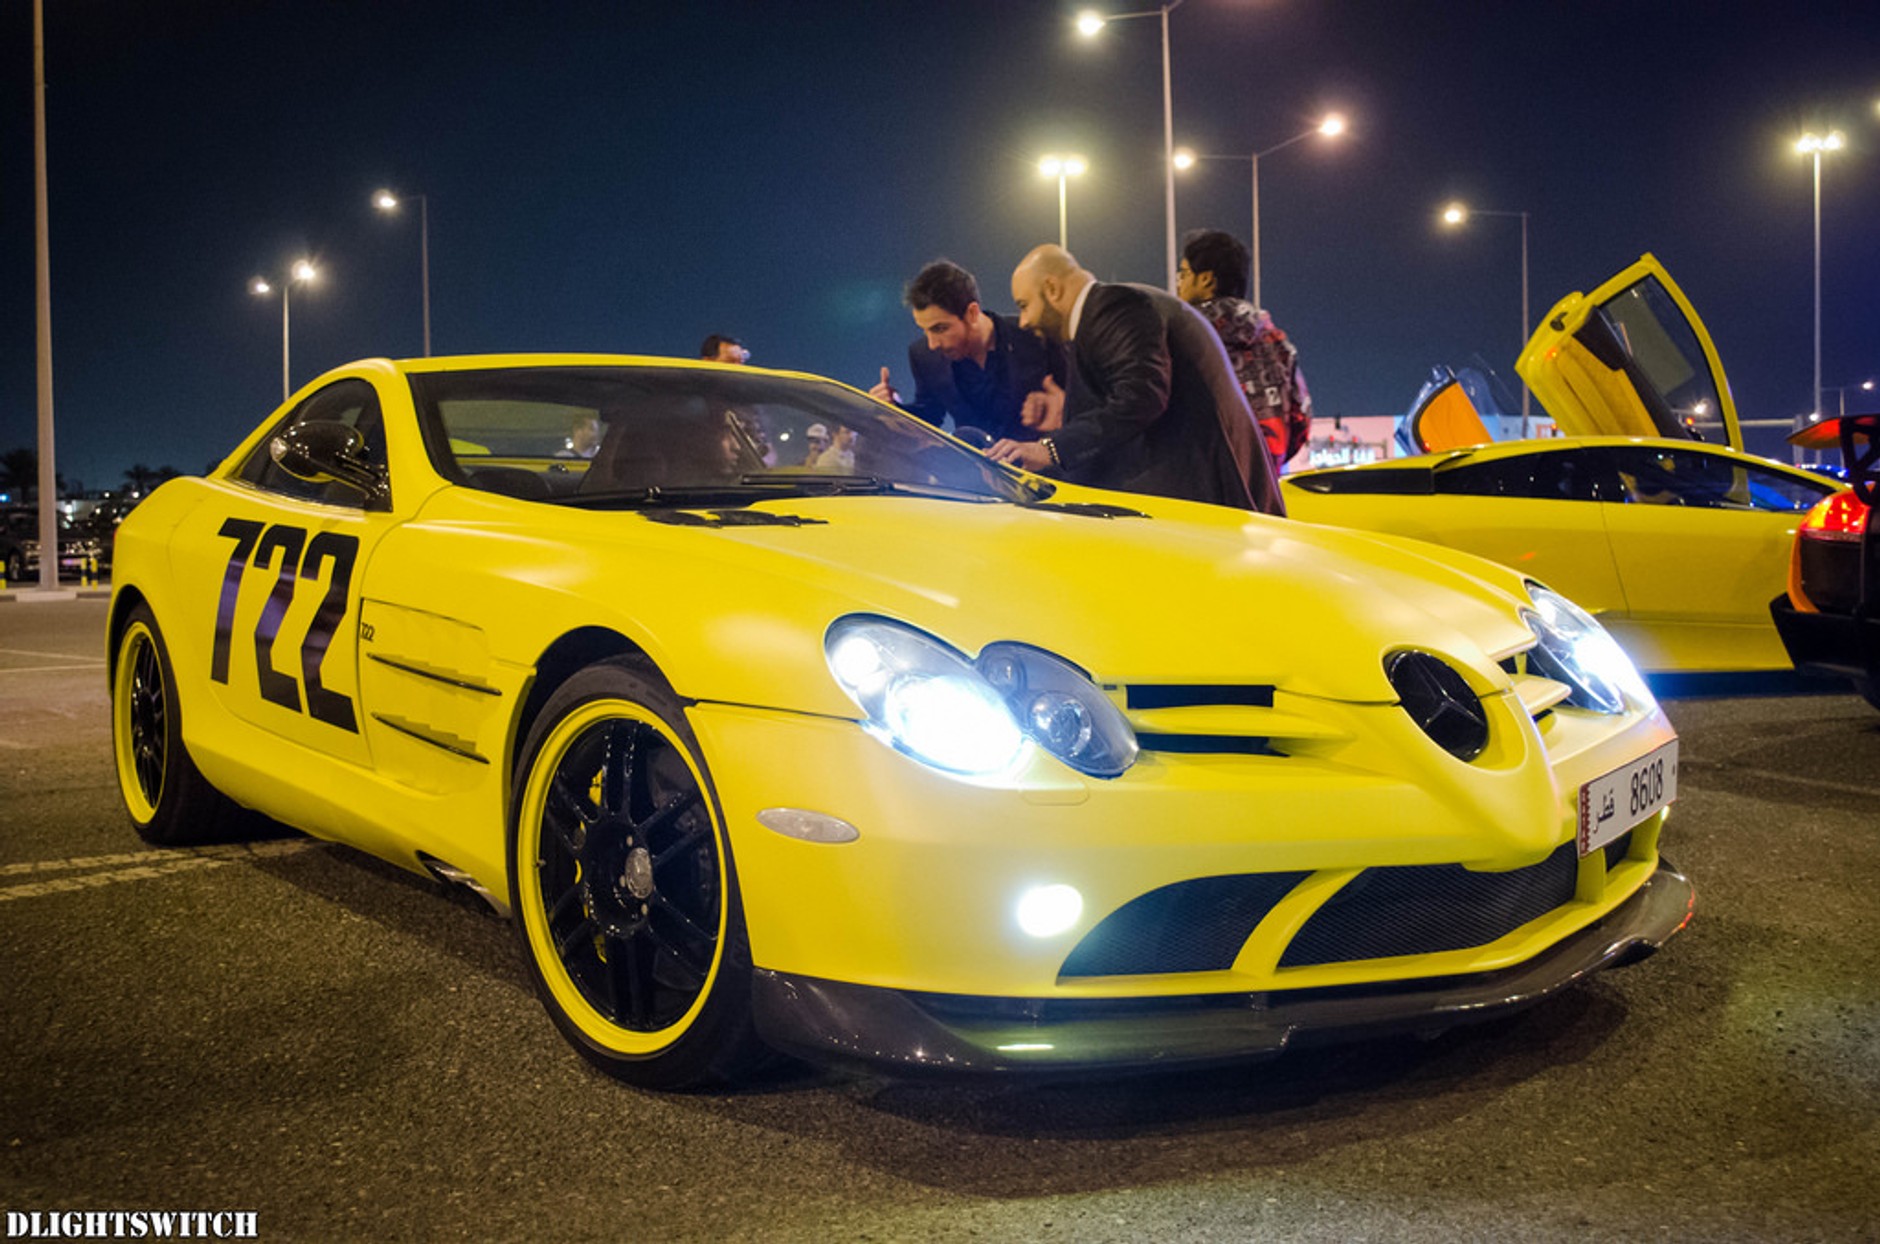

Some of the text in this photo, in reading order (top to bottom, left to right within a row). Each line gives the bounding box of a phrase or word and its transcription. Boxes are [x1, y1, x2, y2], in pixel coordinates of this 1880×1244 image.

[210, 517, 360, 735] 722
[361, 621, 375, 642] 722
[1630, 758, 1664, 816] 8608
